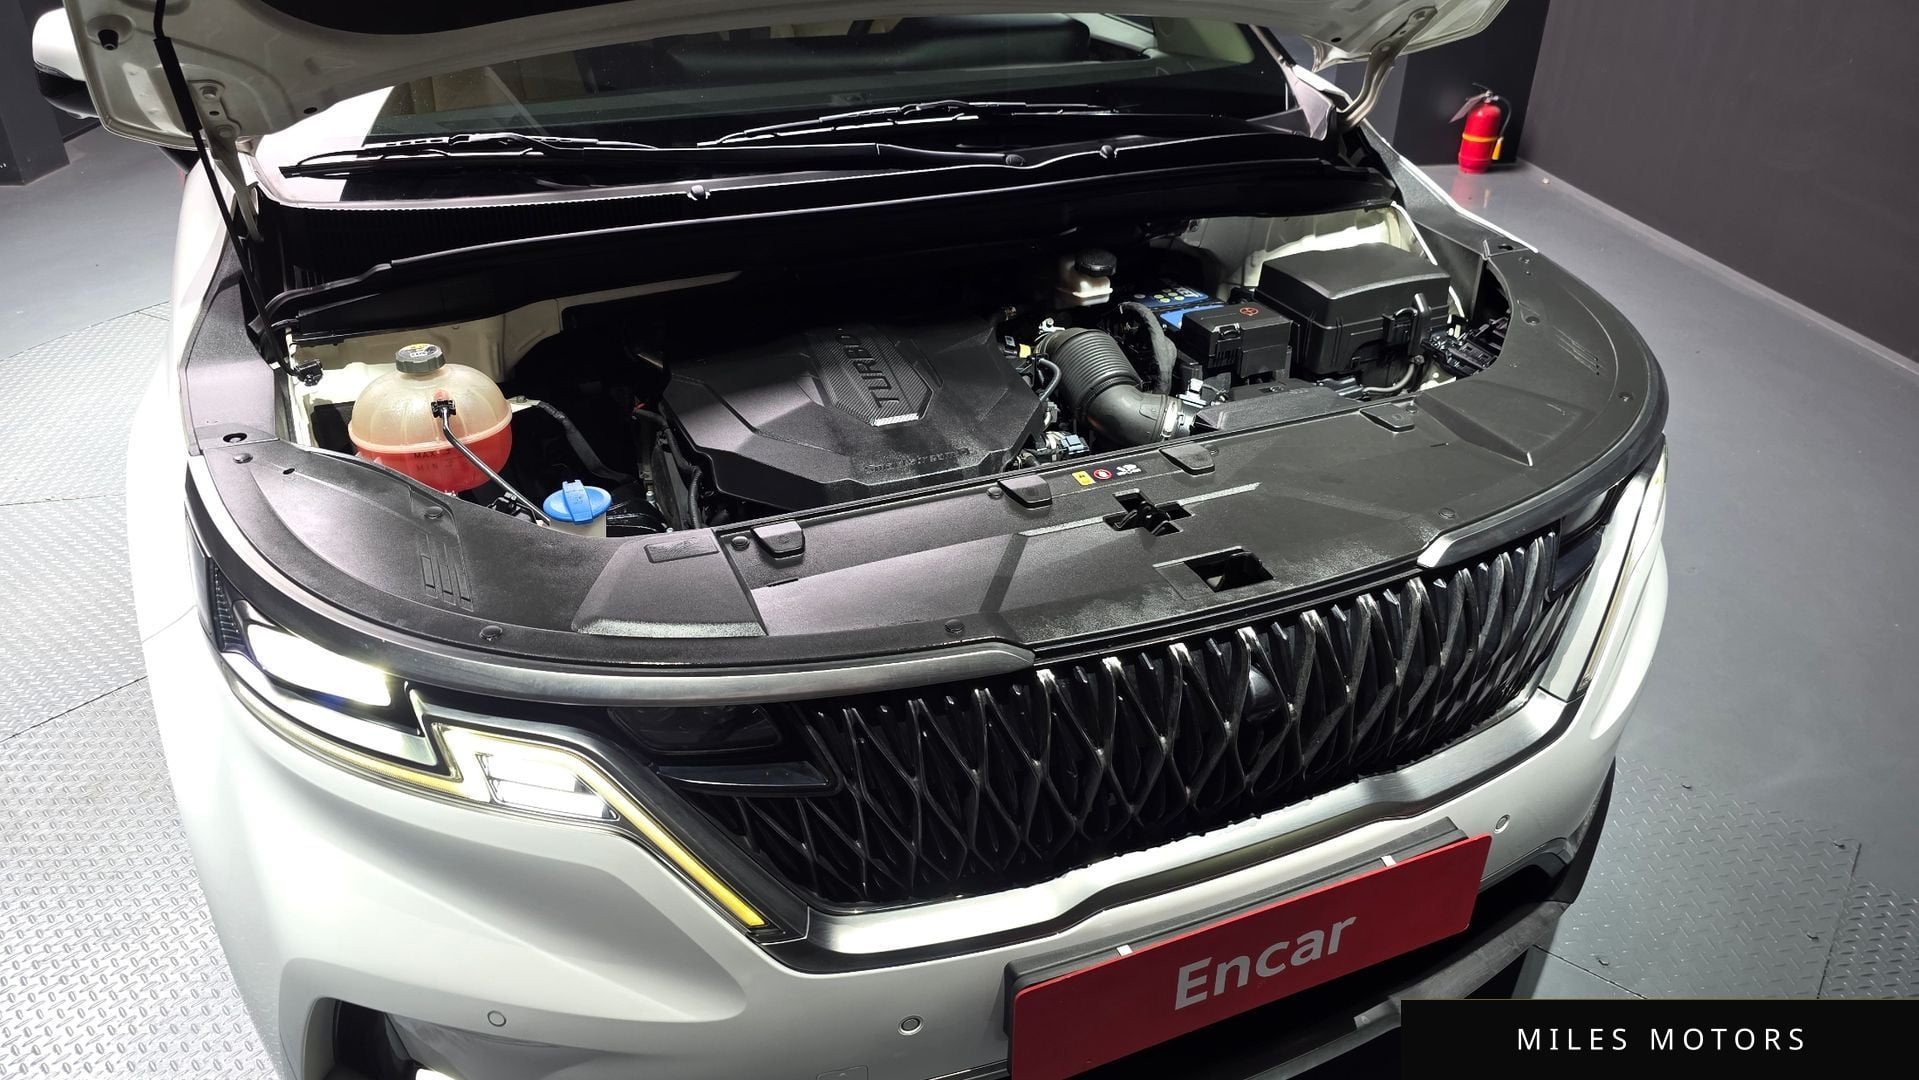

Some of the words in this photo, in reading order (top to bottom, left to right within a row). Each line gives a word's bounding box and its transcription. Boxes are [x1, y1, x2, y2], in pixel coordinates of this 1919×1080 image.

[835, 328, 900, 408] TURBO
[414, 451, 437, 460] MAX
[416, 463, 438, 471] MIN
[1175, 916, 1356, 1010] Encar
